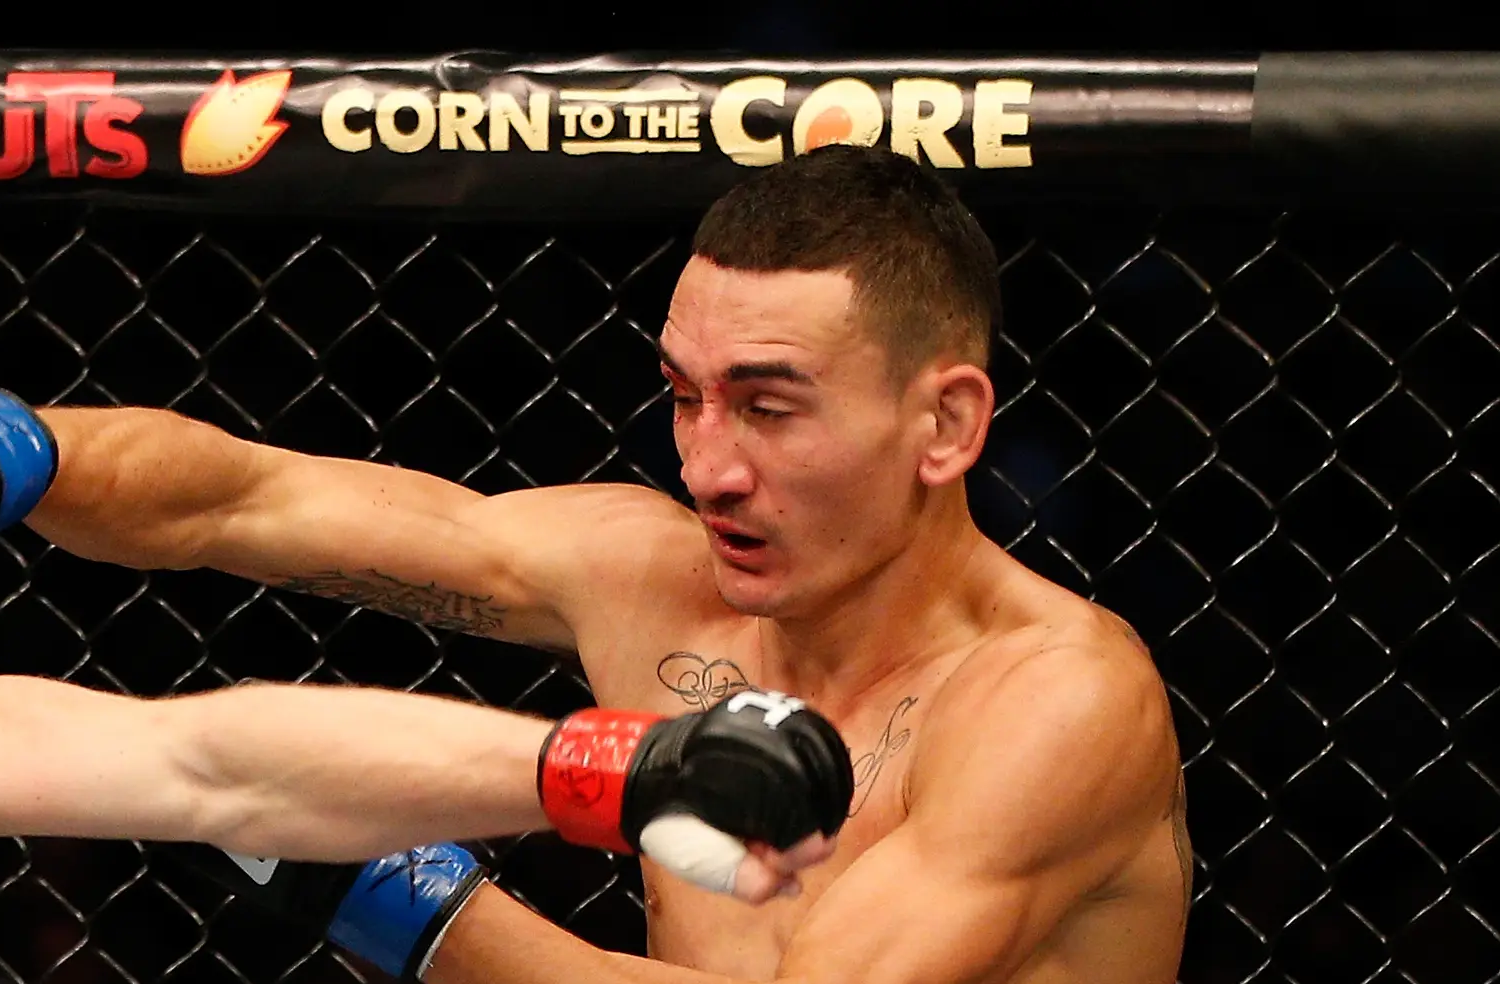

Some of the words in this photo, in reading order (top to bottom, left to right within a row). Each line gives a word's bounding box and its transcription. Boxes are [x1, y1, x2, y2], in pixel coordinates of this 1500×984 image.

[320, 88, 552, 154] CORN
[560, 104, 614, 139] TO
[623, 105, 700, 140] THE
[710, 76, 1035, 169] CORE
